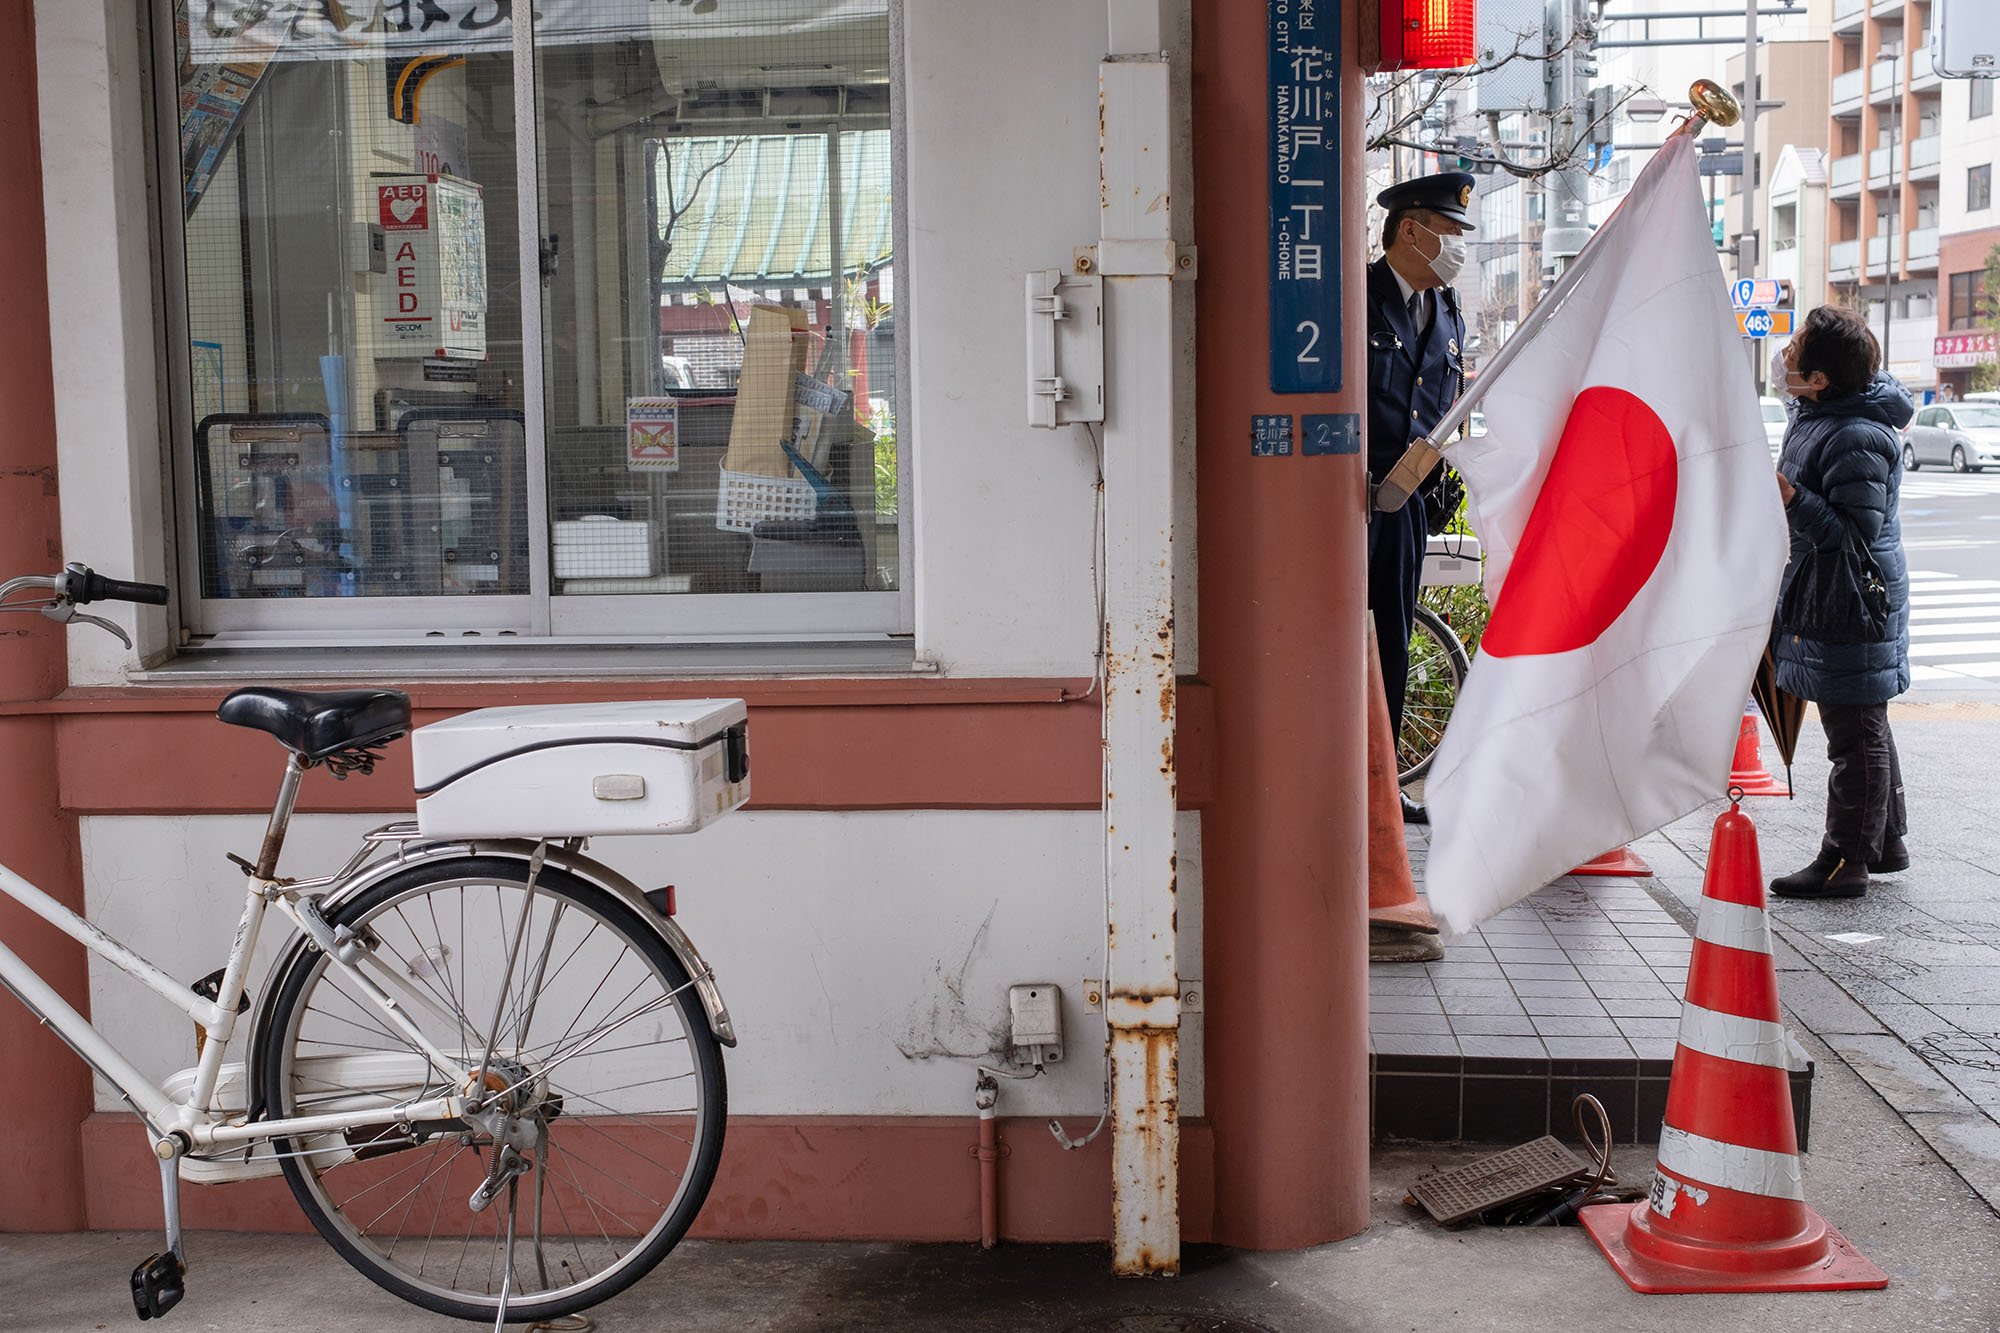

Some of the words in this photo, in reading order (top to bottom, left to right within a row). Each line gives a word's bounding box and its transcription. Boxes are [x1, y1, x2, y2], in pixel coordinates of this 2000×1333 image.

[1276, 22, 1290, 55] CITY
[1276, 85, 1291, 184] HANAKAWADO
[1290, 45, 1325, 280] 花川戸一丁目
[382, 186, 424, 198] AED
[1278, 216, 1291, 280] 1-CHOME
[1741, 283, 1750, 300] 6
[395, 323, 422, 332] SECOM
[1747, 315, 1770, 331] 463
[1296, 320, 1321, 363] 2
[1256, 418, 1289, 426] 台東区
[1256, 428, 1289, 441] 花川戸
[1257, 441, 1289, 453] 1丁目
